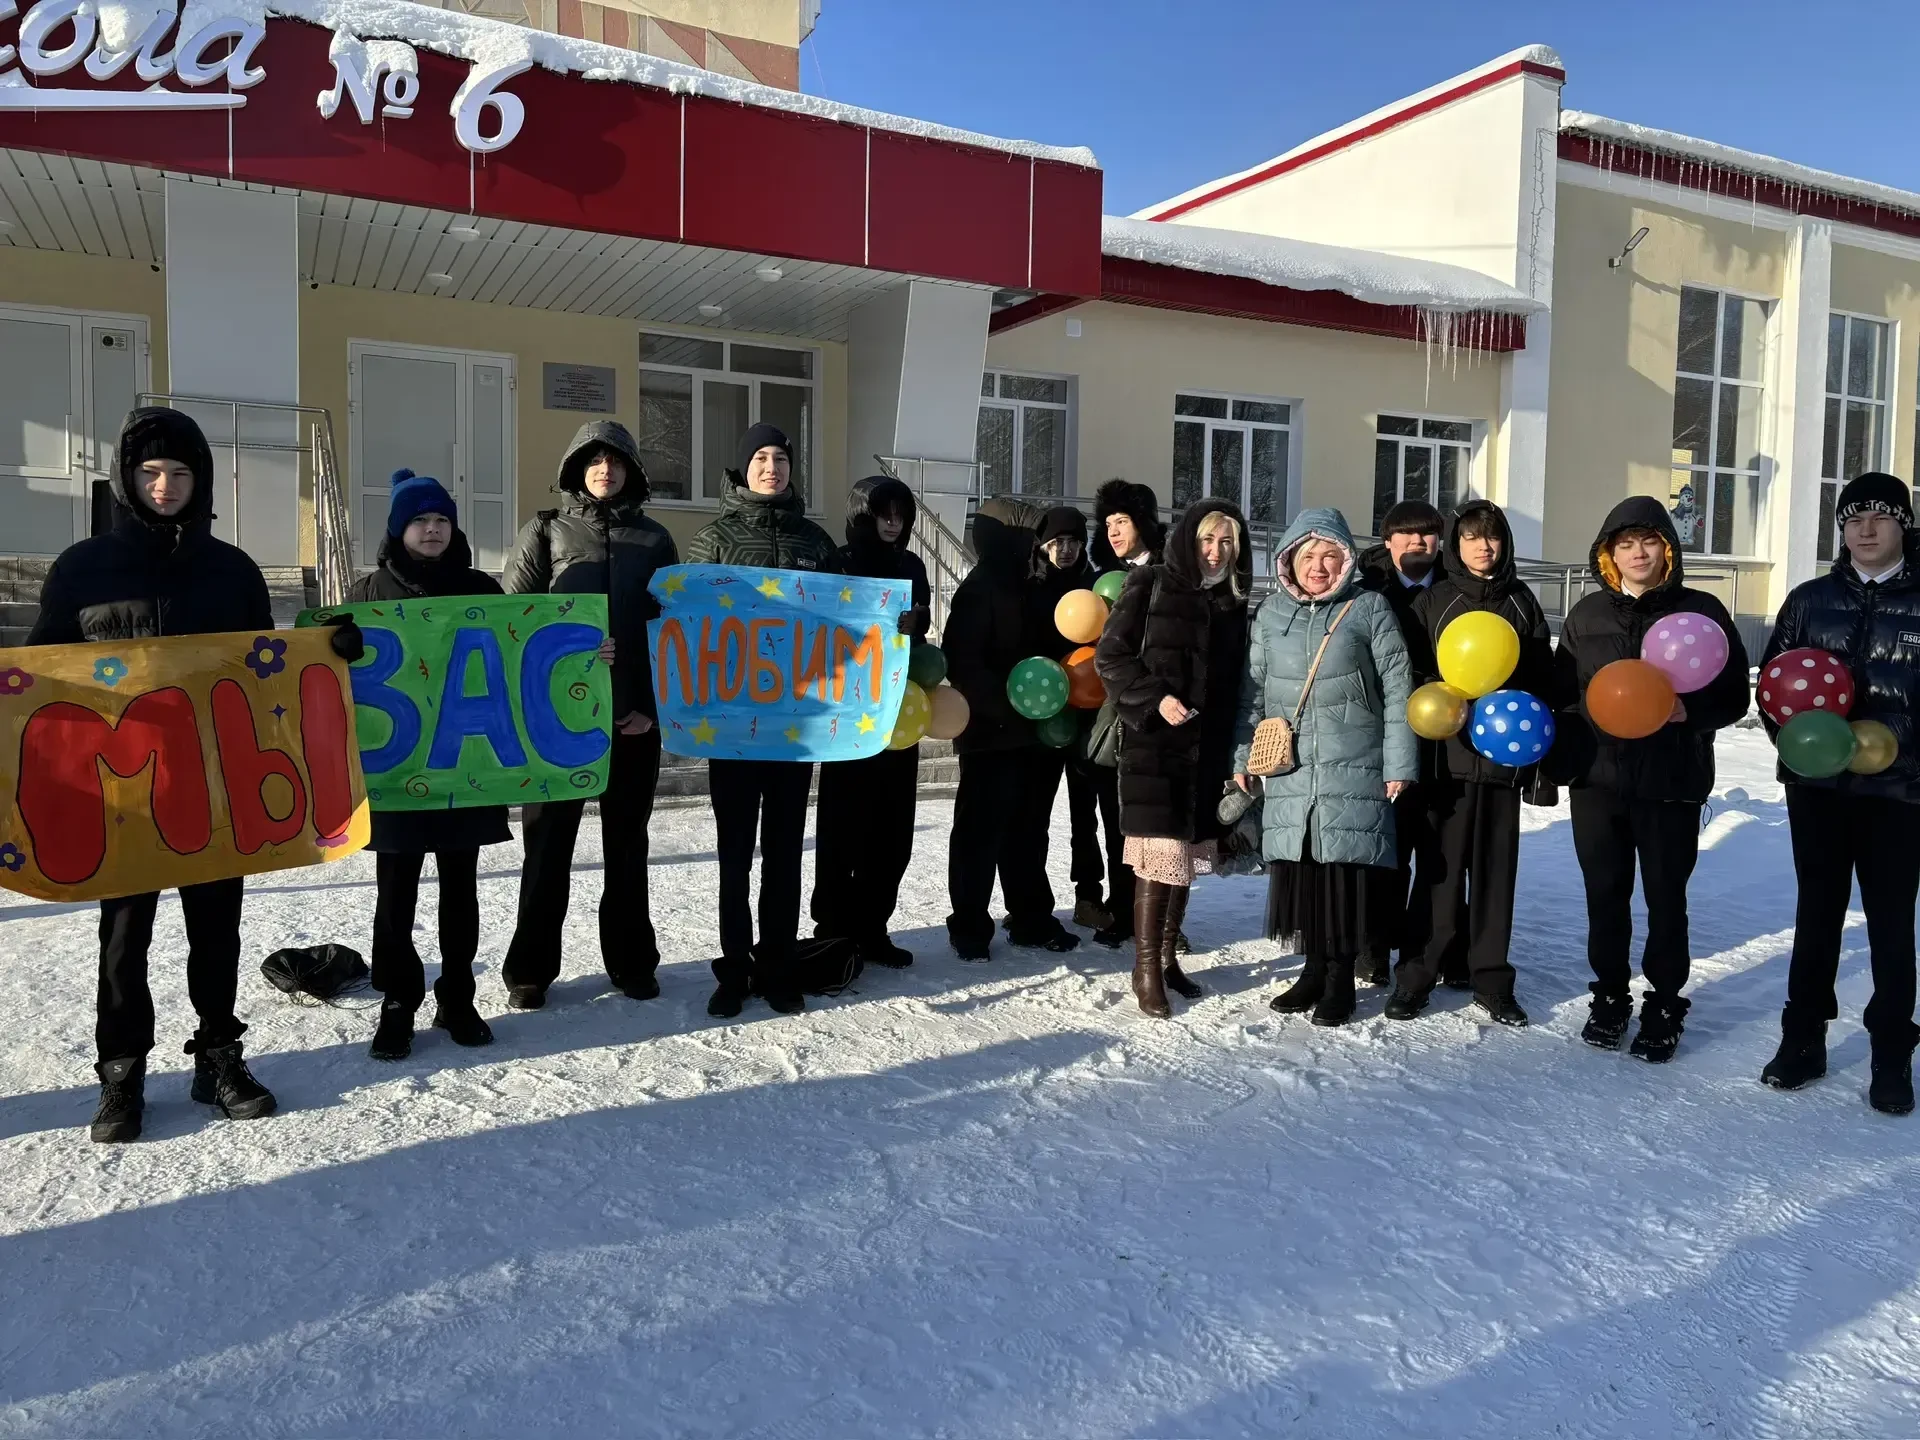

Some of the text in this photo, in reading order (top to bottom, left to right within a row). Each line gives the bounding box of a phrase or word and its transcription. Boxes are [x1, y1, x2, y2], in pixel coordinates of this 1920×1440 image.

[0, 0, 266, 89] ола
[456, 60, 533, 152] 6
[348, 623, 610, 774] ВАС
[656, 615, 884, 706] ЛЮБИМ
[16, 663, 353, 884] МЫ
